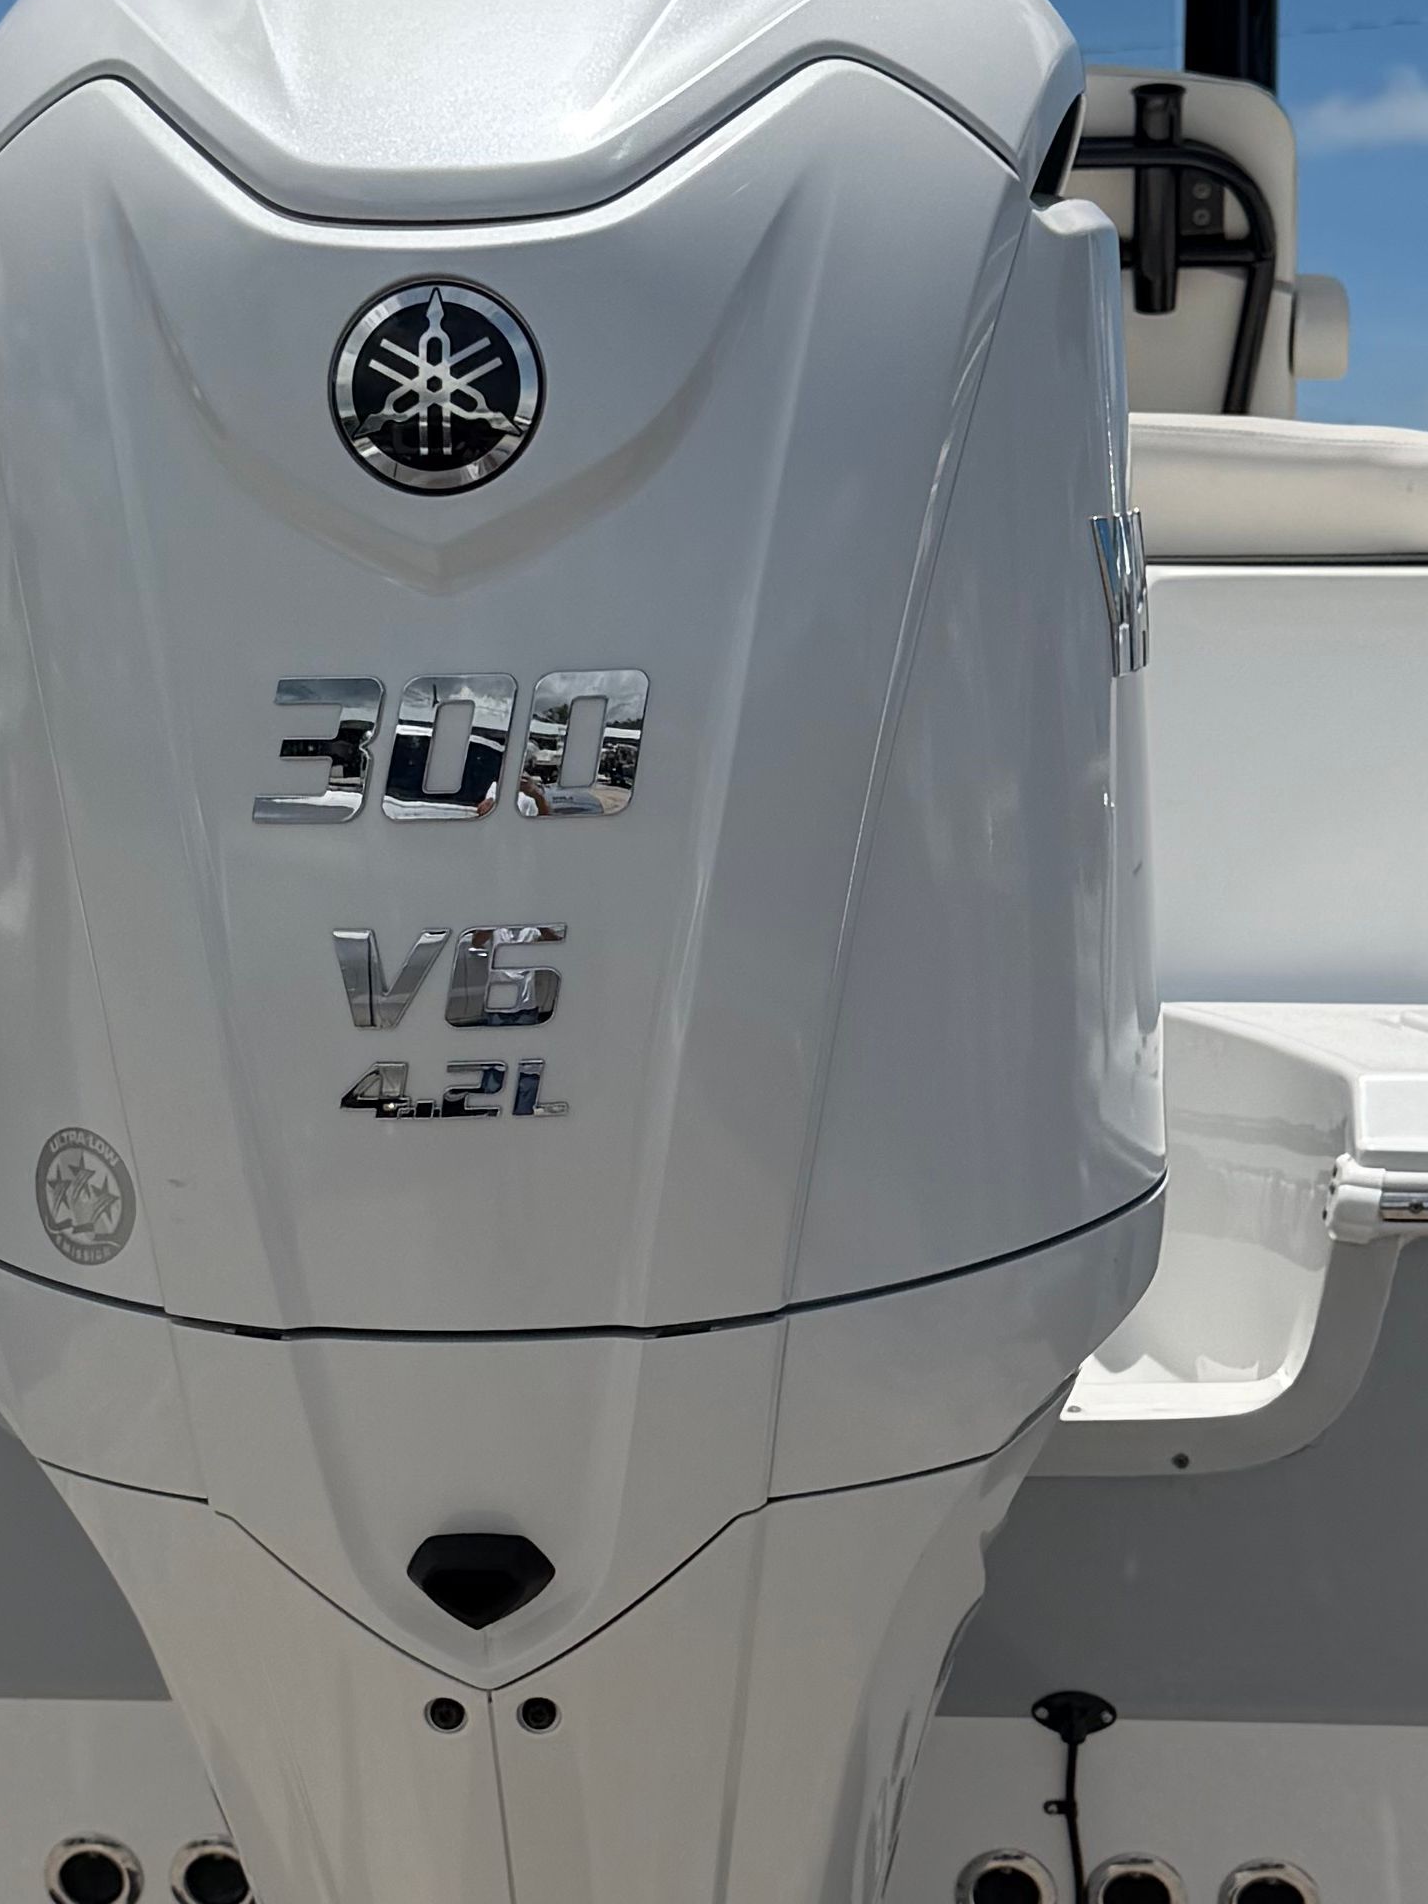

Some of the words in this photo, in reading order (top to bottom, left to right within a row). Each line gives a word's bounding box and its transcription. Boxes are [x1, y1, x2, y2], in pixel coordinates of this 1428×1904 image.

[252, 668, 650, 824] 300
[333, 923, 568, 1029] V6
[340, 1059, 570, 1120] 4.2L
[49, 1130, 86, 1153] ULTRA
[86, 1136, 121, 1167] LOW
